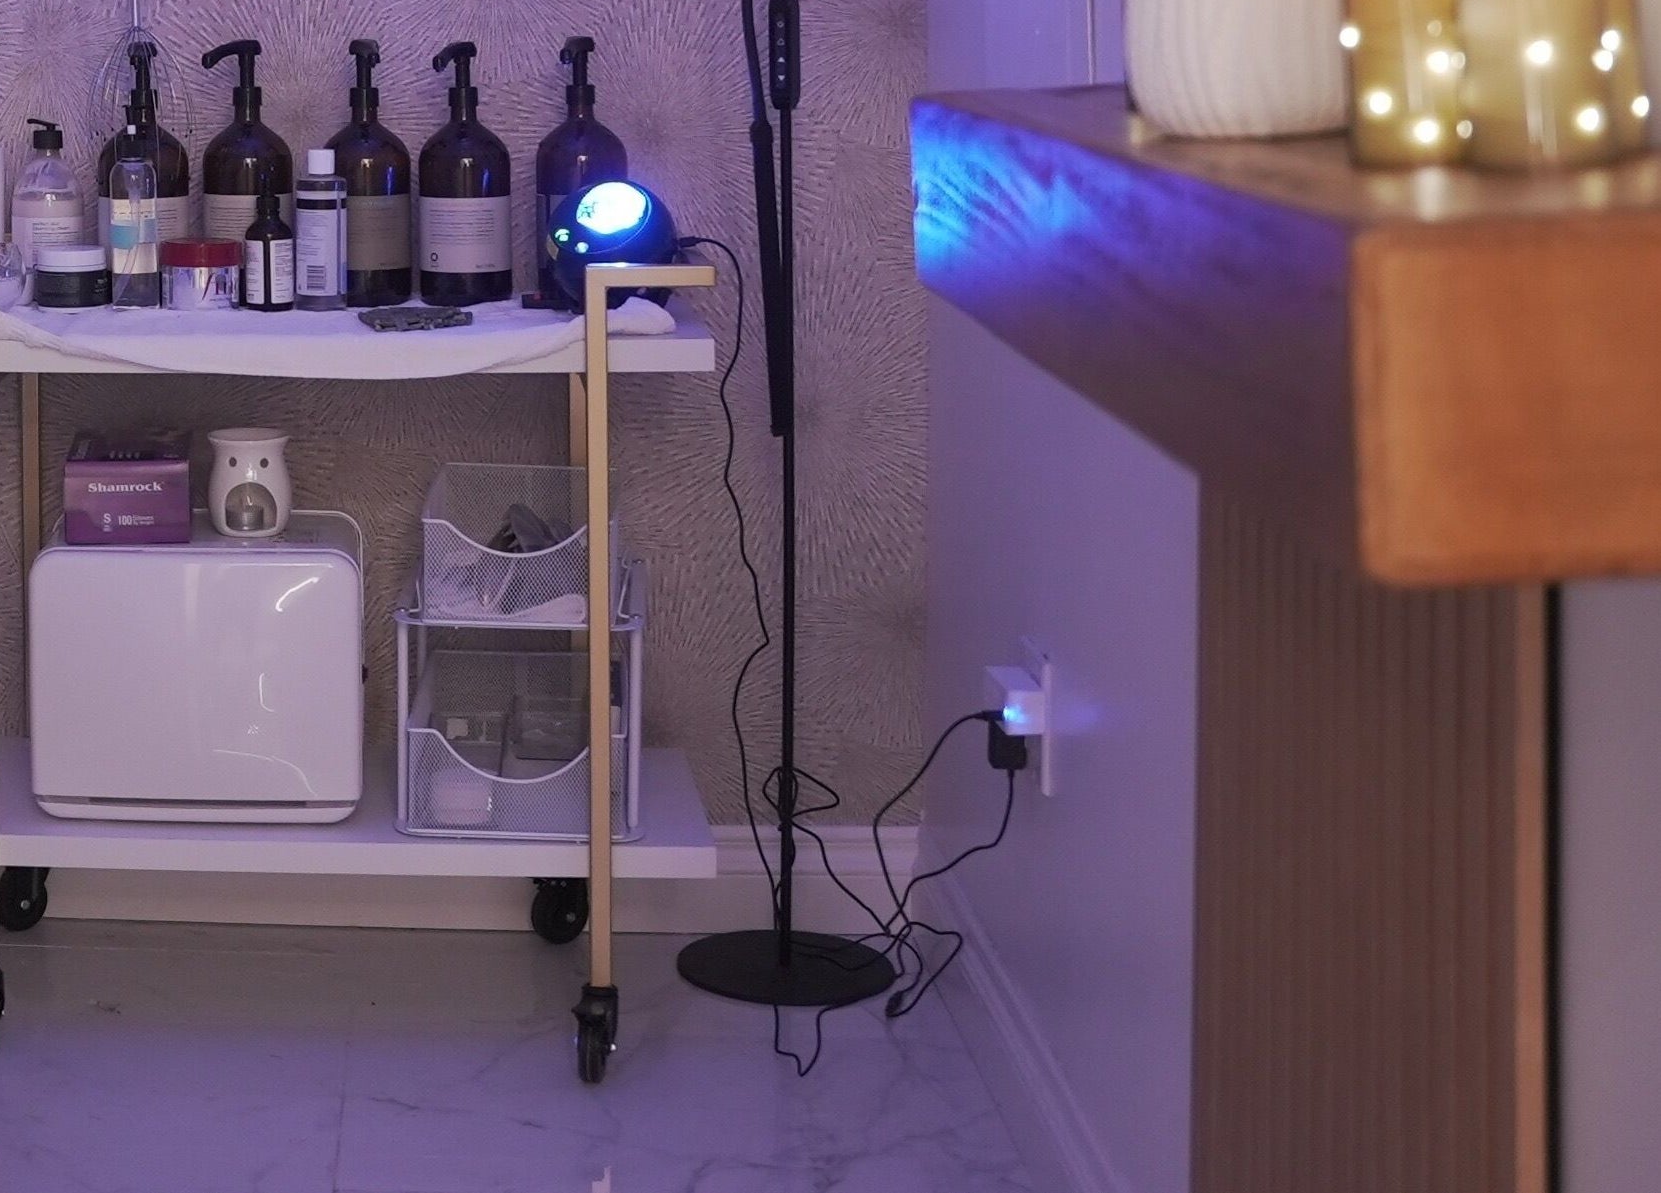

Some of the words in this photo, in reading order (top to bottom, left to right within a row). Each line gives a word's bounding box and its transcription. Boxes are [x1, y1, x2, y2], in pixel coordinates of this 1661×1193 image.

[87, 481, 163, 493] Shamrock
[103, 513, 112, 524] S
[118, 515, 132, 526] 100
